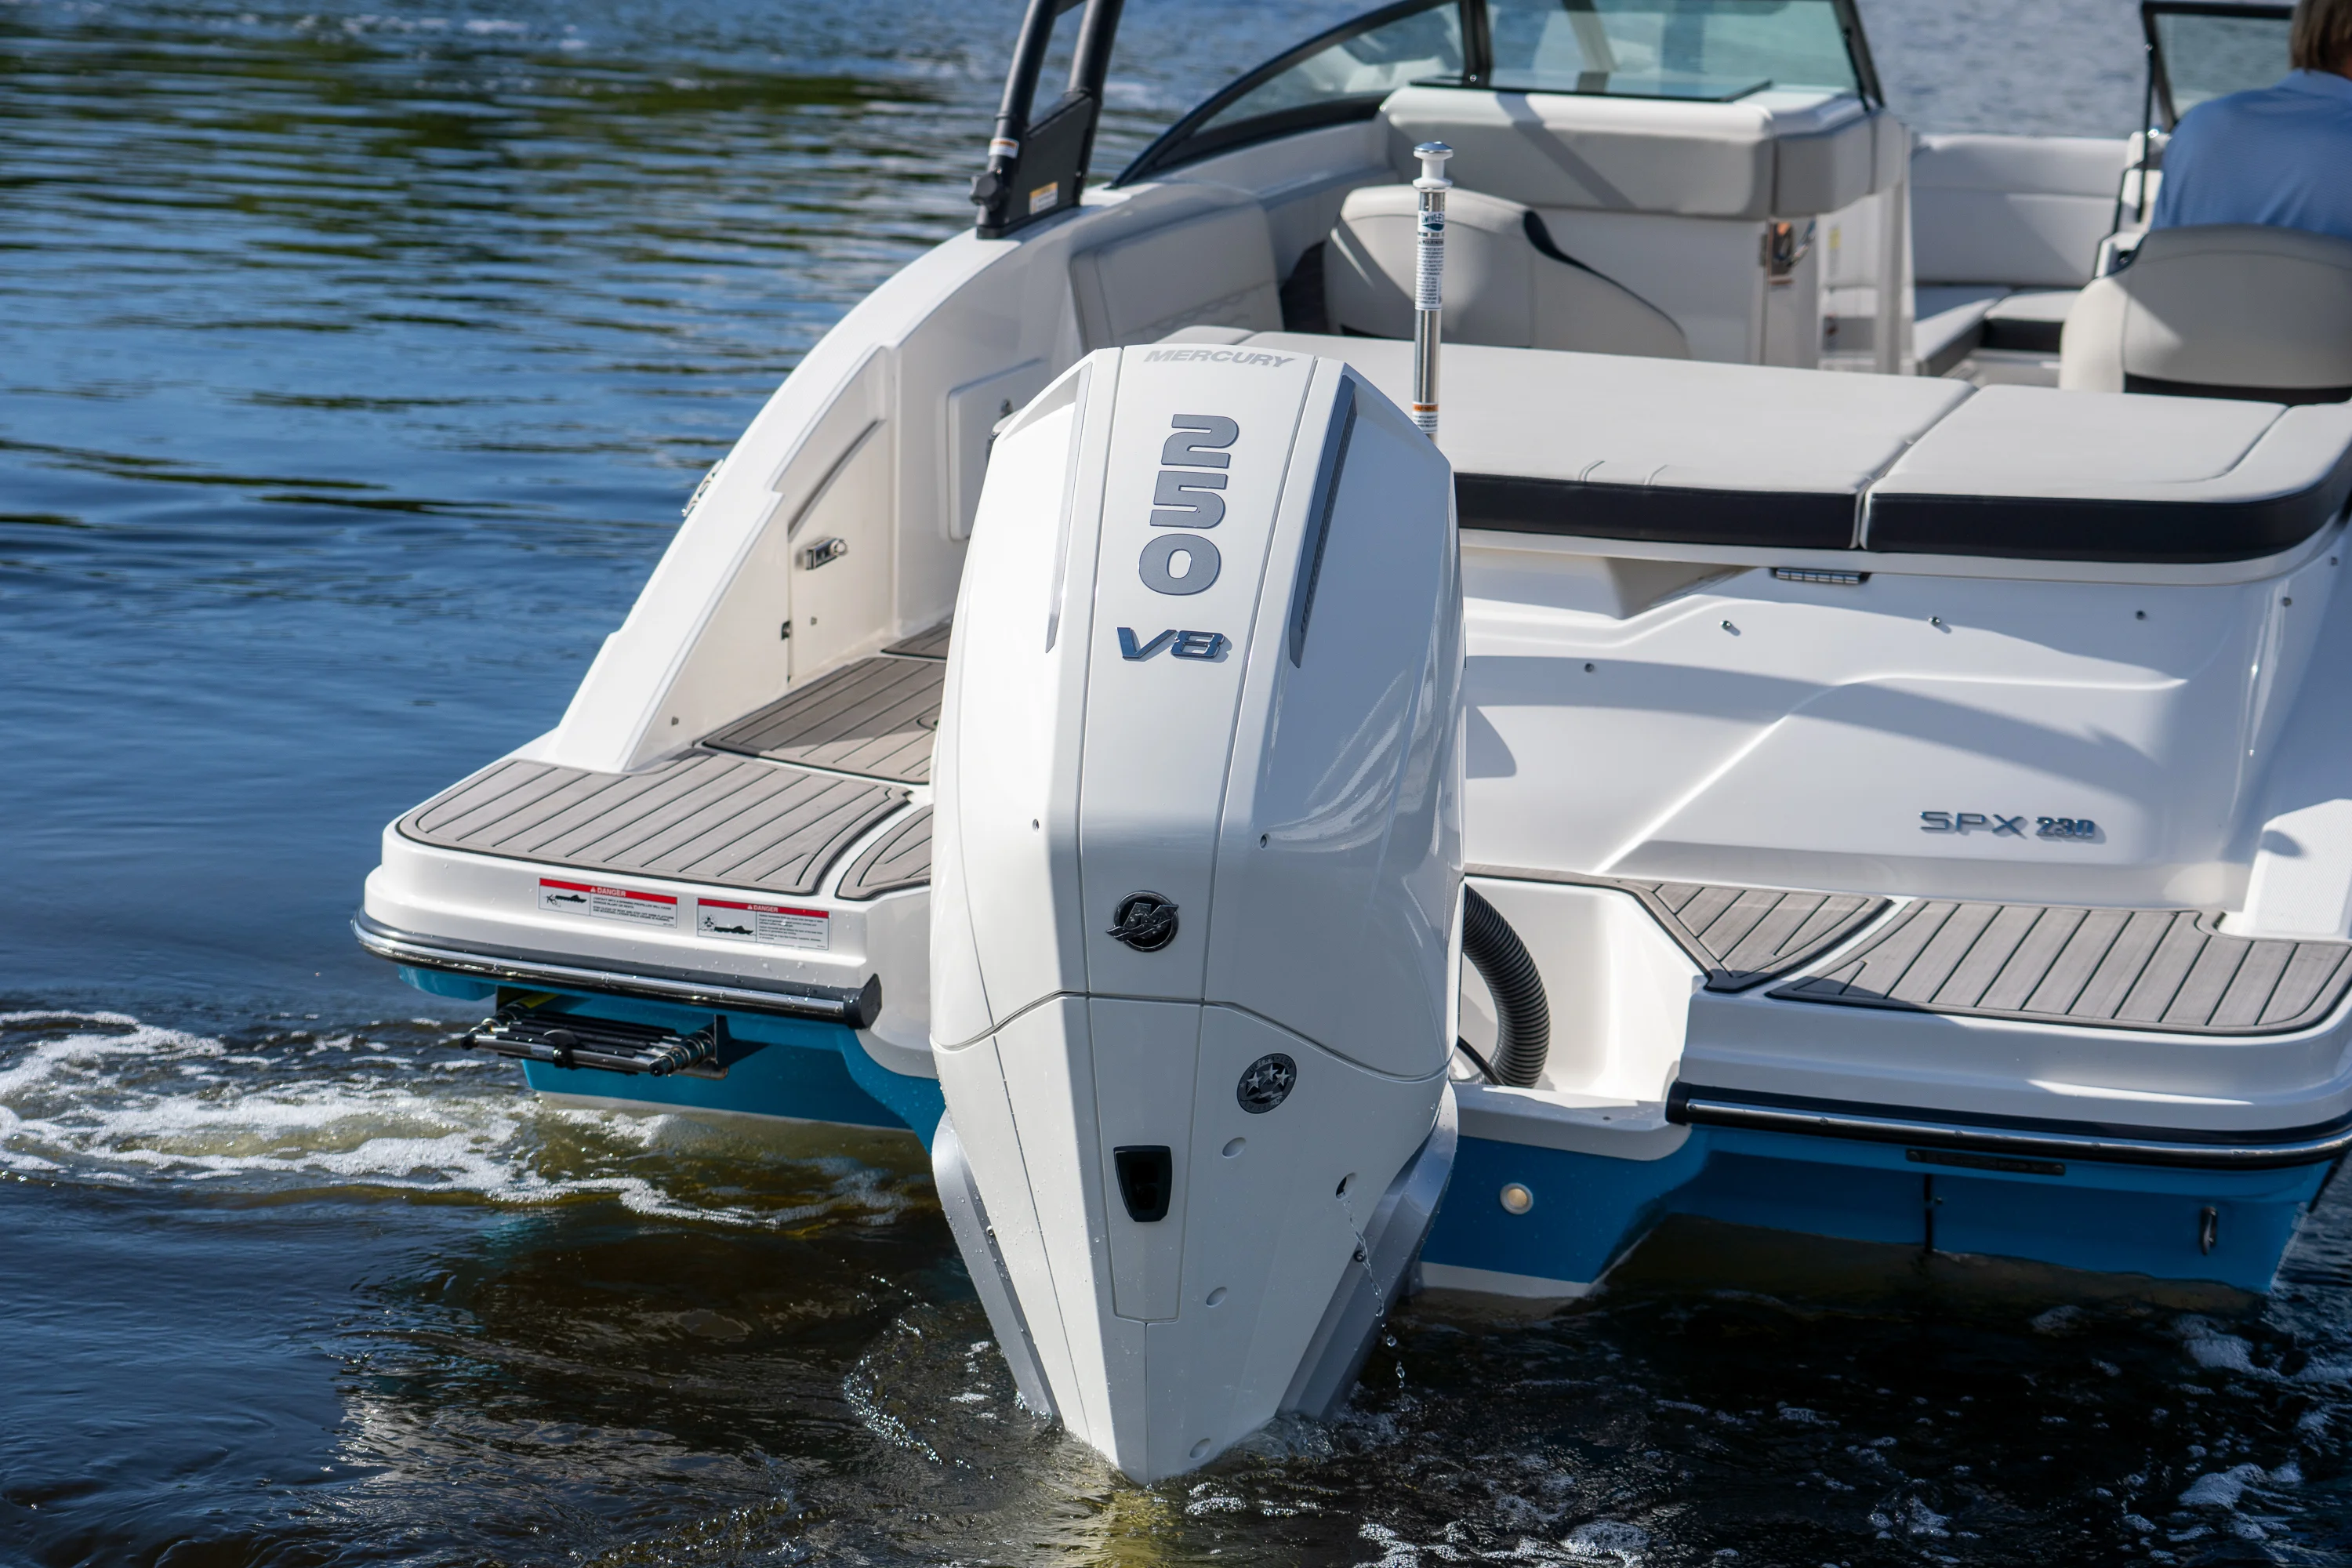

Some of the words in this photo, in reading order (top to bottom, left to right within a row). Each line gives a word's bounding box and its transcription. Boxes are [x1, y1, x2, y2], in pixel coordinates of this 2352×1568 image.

[1143, 350, 1296, 368] MERCURY
[1138, 413, 1240, 596] 250
[1116, 626, 1228, 661] V8
[1919, 811, 2027, 839] SPX
[2035, 816, 2096, 838] 230
[597, 887, 626, 897] DANGER
